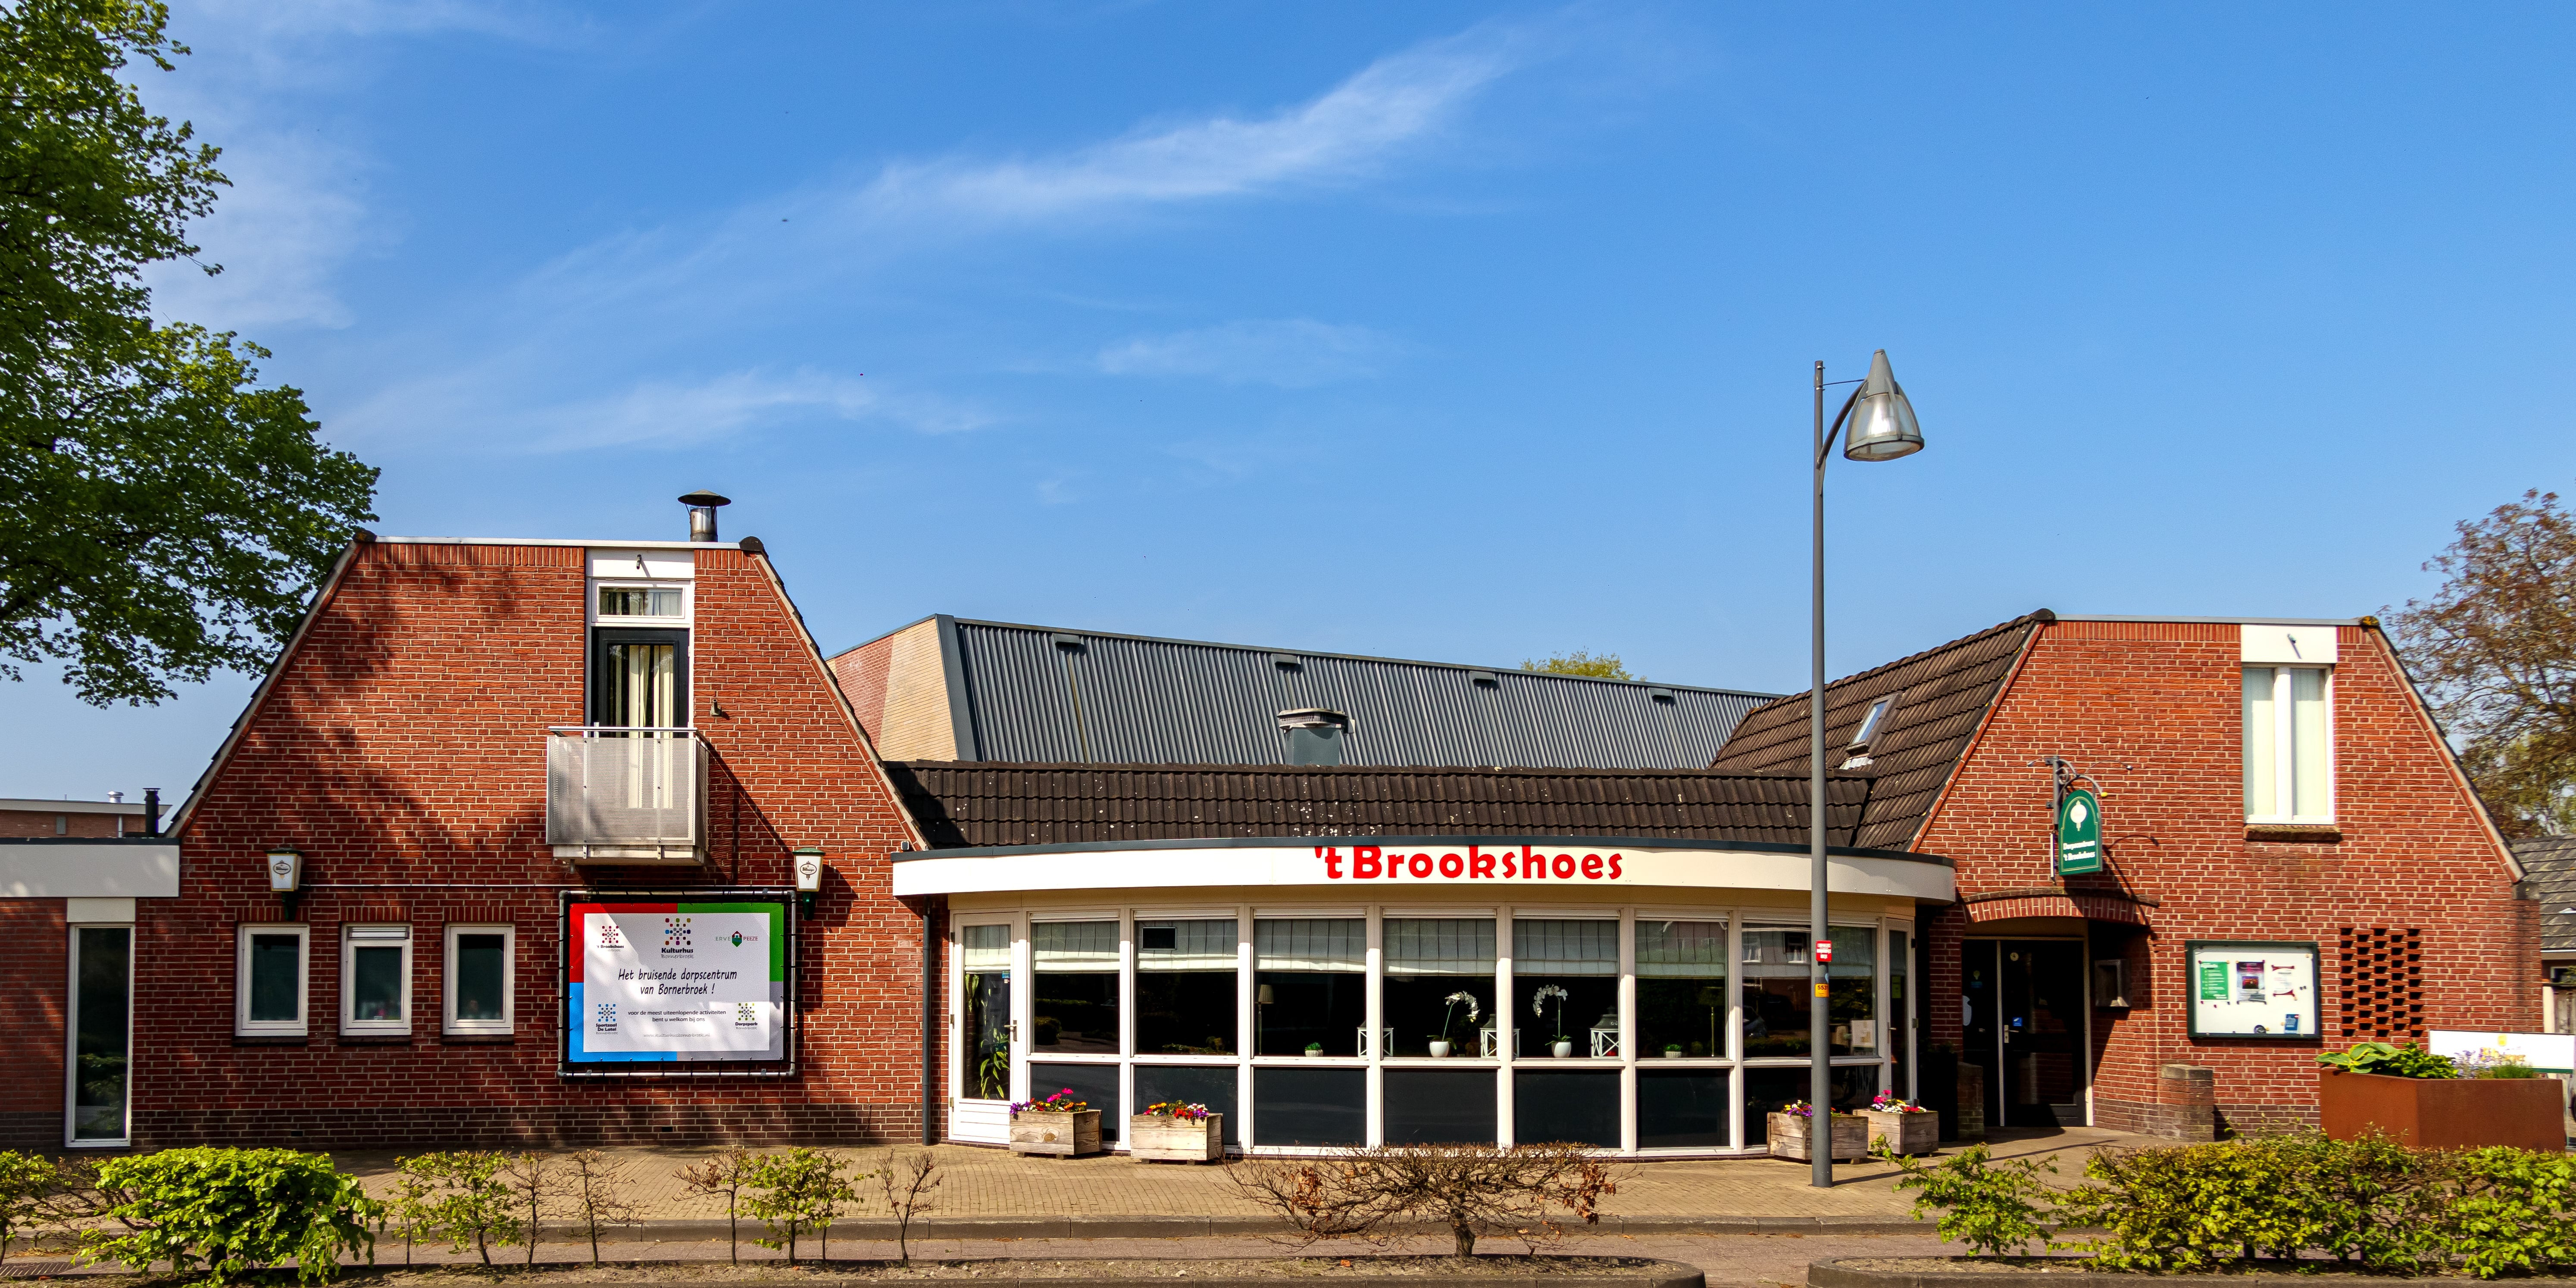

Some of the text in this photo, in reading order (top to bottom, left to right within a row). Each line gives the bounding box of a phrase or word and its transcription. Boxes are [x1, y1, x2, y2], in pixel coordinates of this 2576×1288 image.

[1315, 845, 1623, 880] 't Brookshoes
[618, 968, 738, 983] Het bruisende dorpscentrum
[640, 986, 654, 994] van
[658, 983, 708, 995] Bornerbroek
